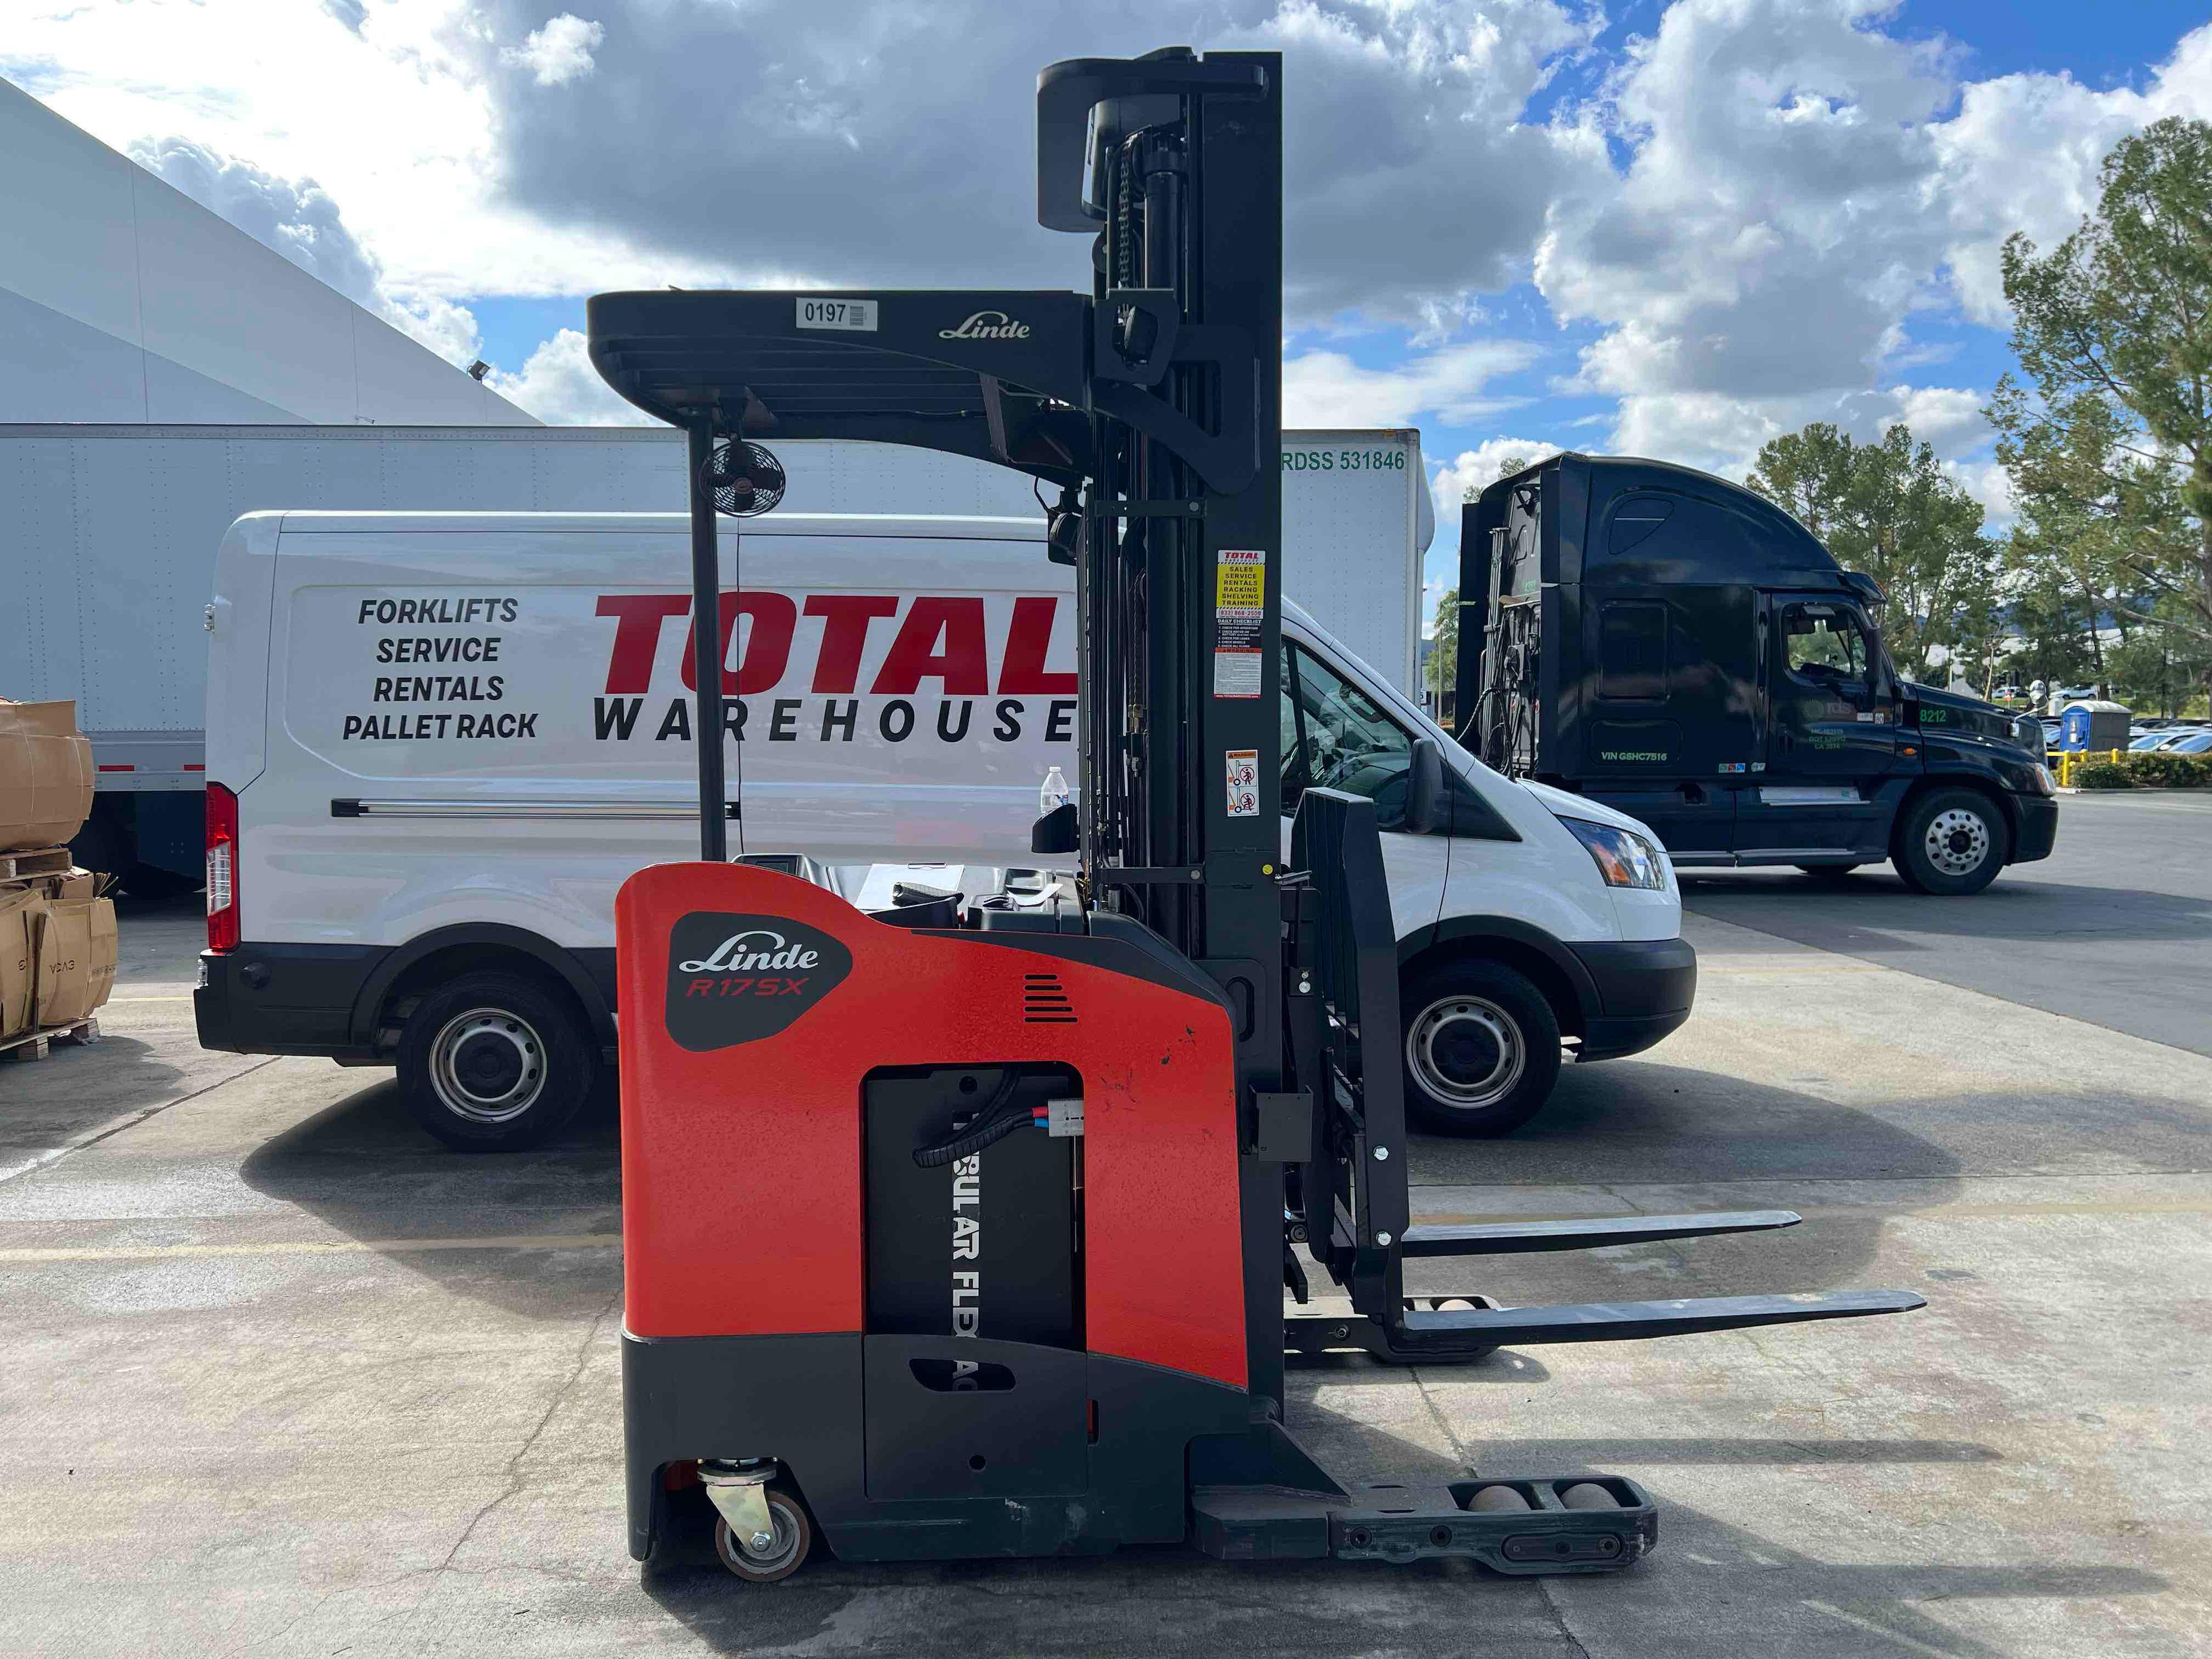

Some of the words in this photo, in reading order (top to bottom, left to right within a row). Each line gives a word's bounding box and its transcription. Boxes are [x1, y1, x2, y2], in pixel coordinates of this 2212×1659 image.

[805, 303, 846, 322] 0197
[939, 310, 1030, 339] Linde
[1281, 452, 1334, 470] RDSS
[1340, 451, 1404, 470] 531846
[358, 598, 518, 624] FORKLIFTS
[376, 637, 501, 663] SERVICE
[594, 591, 1078, 696] TOTAL
[373, 676, 504, 702] RENTALS
[343, 714, 452, 740] PALLET
[456, 713, 539, 738] RACK
[594, 698, 1077, 743] WAREHOUSE
[1919, 709, 1946, 722] 8212
[1601, 752, 1618, 760] VIN
[679, 930, 819, 972] Linde
[685, 978, 809, 997] R17SX
